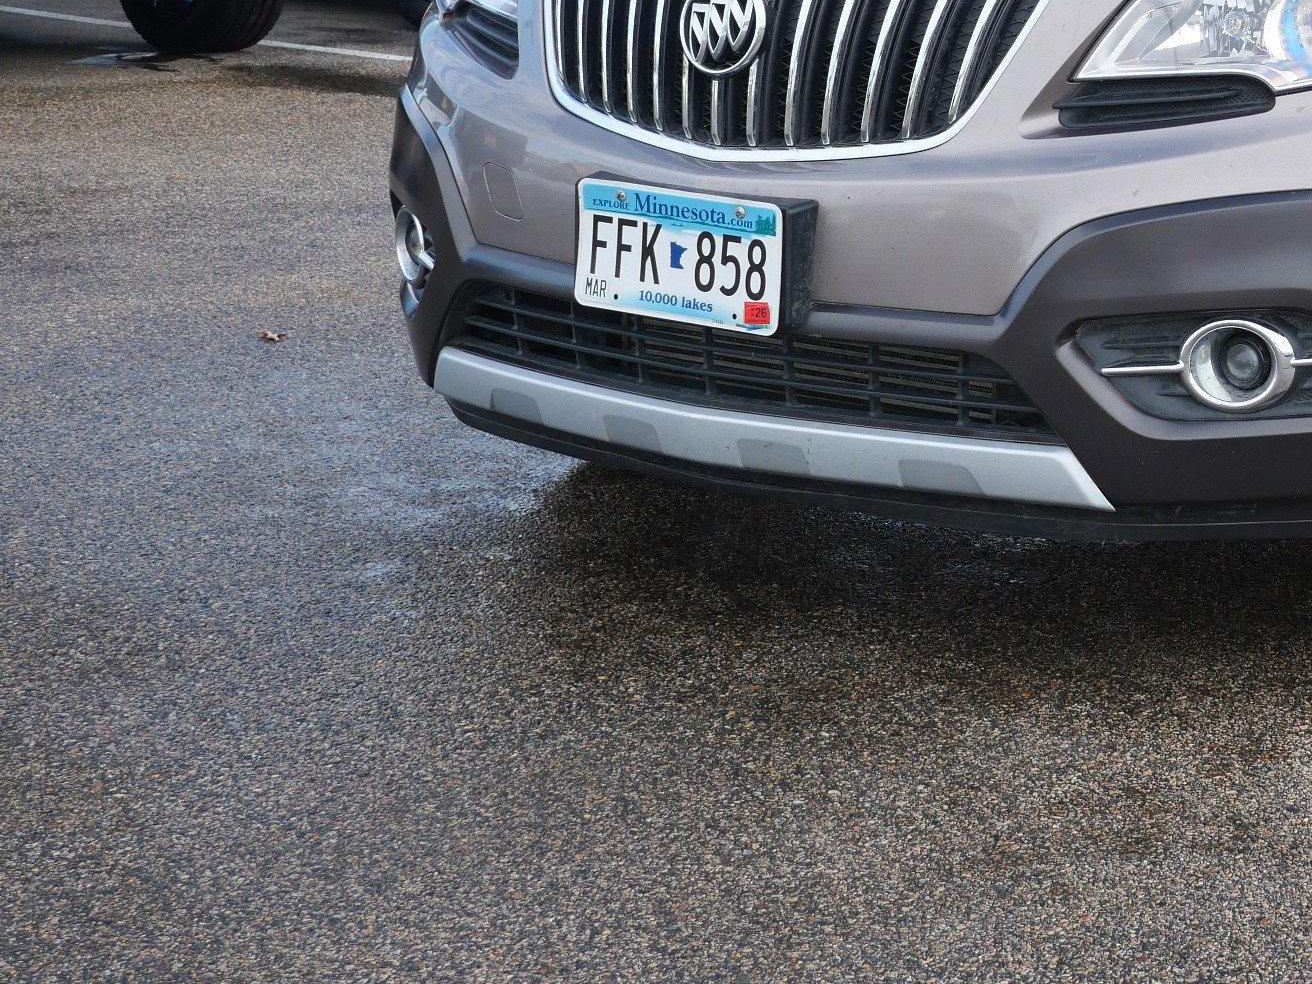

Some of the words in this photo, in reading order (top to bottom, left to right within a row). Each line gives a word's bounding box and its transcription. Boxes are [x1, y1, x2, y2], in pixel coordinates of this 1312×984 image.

[592, 198, 630, 211] EXPLORE
[589, 214, 663, 285] FFK
[694, 230, 767, 301] 858
[584, 276, 608, 299] MAR
[638, 290, 678, 307] 10,000
[681, 295, 713, 313] lakes
[755, 307, 767, 318] 26
